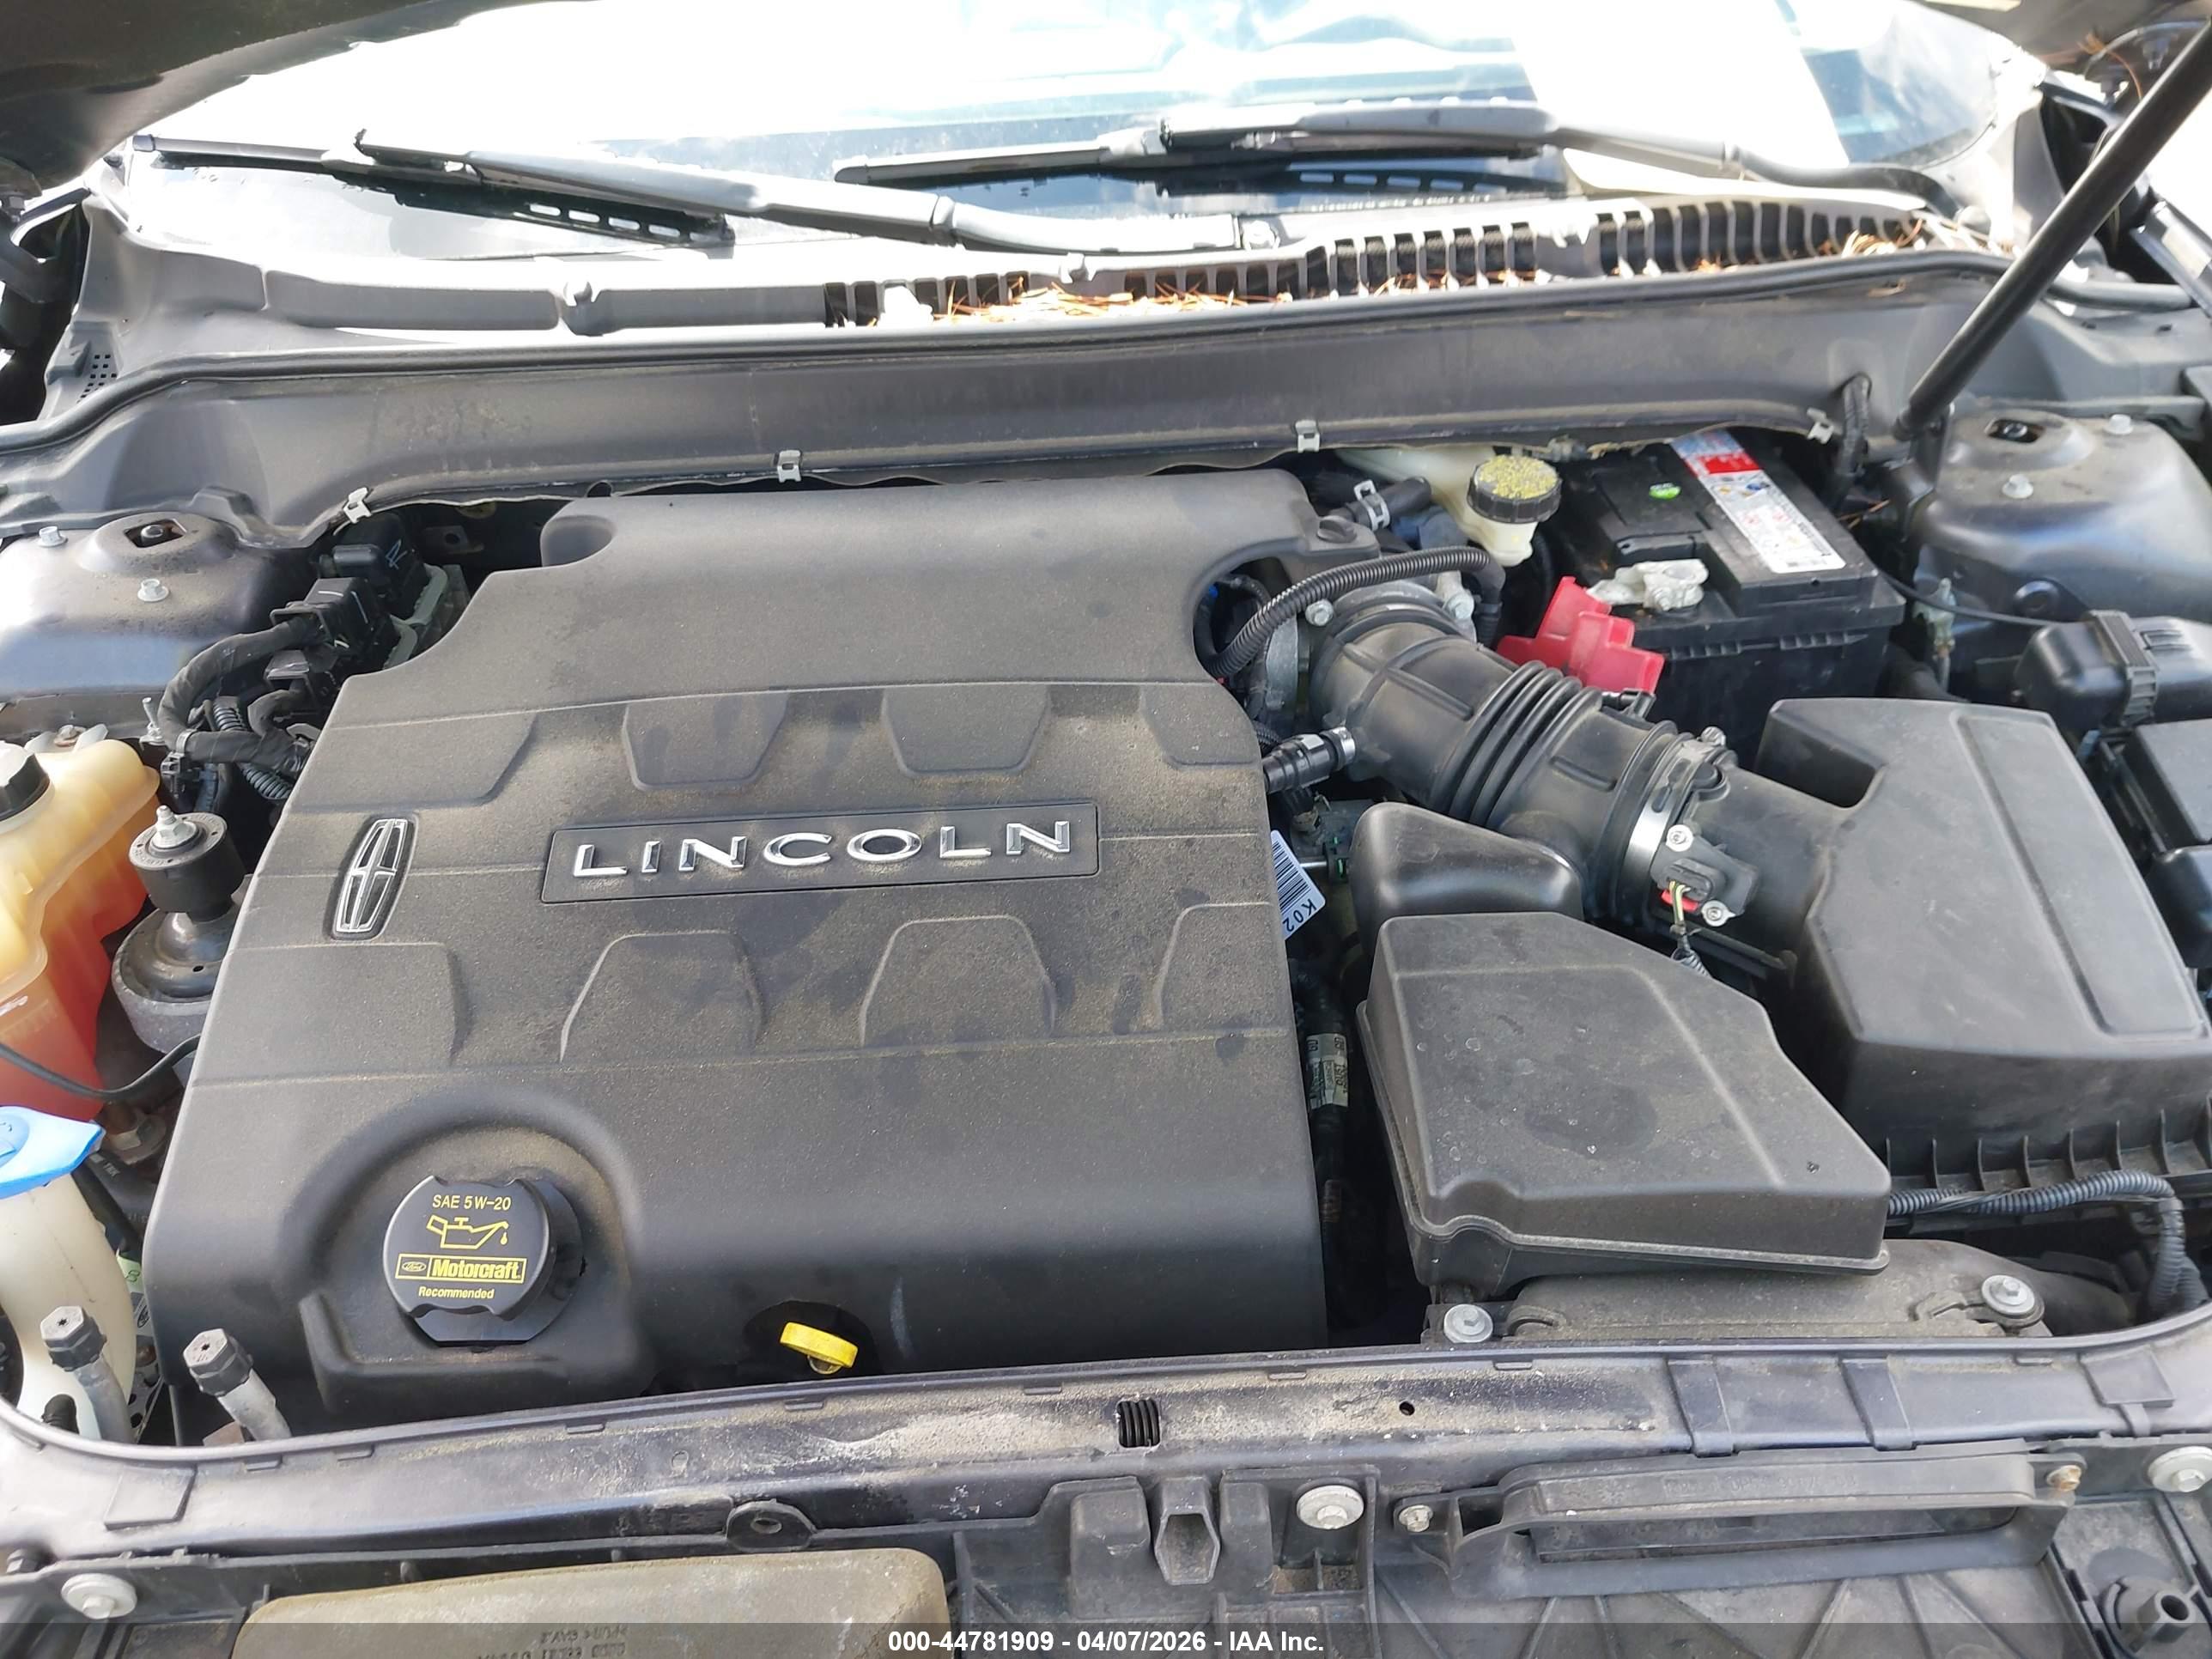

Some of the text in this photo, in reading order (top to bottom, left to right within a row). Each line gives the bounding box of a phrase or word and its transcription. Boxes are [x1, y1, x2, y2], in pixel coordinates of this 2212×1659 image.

[574, 820, 1072, 878] LINCOLN
[1282, 898, 1317, 933] K02
[432, 1194, 512, 1211] SAE 5W-20
[431, 1258, 520, 1279] Motorcraft
[418, 1286, 495, 1299] Recommended
